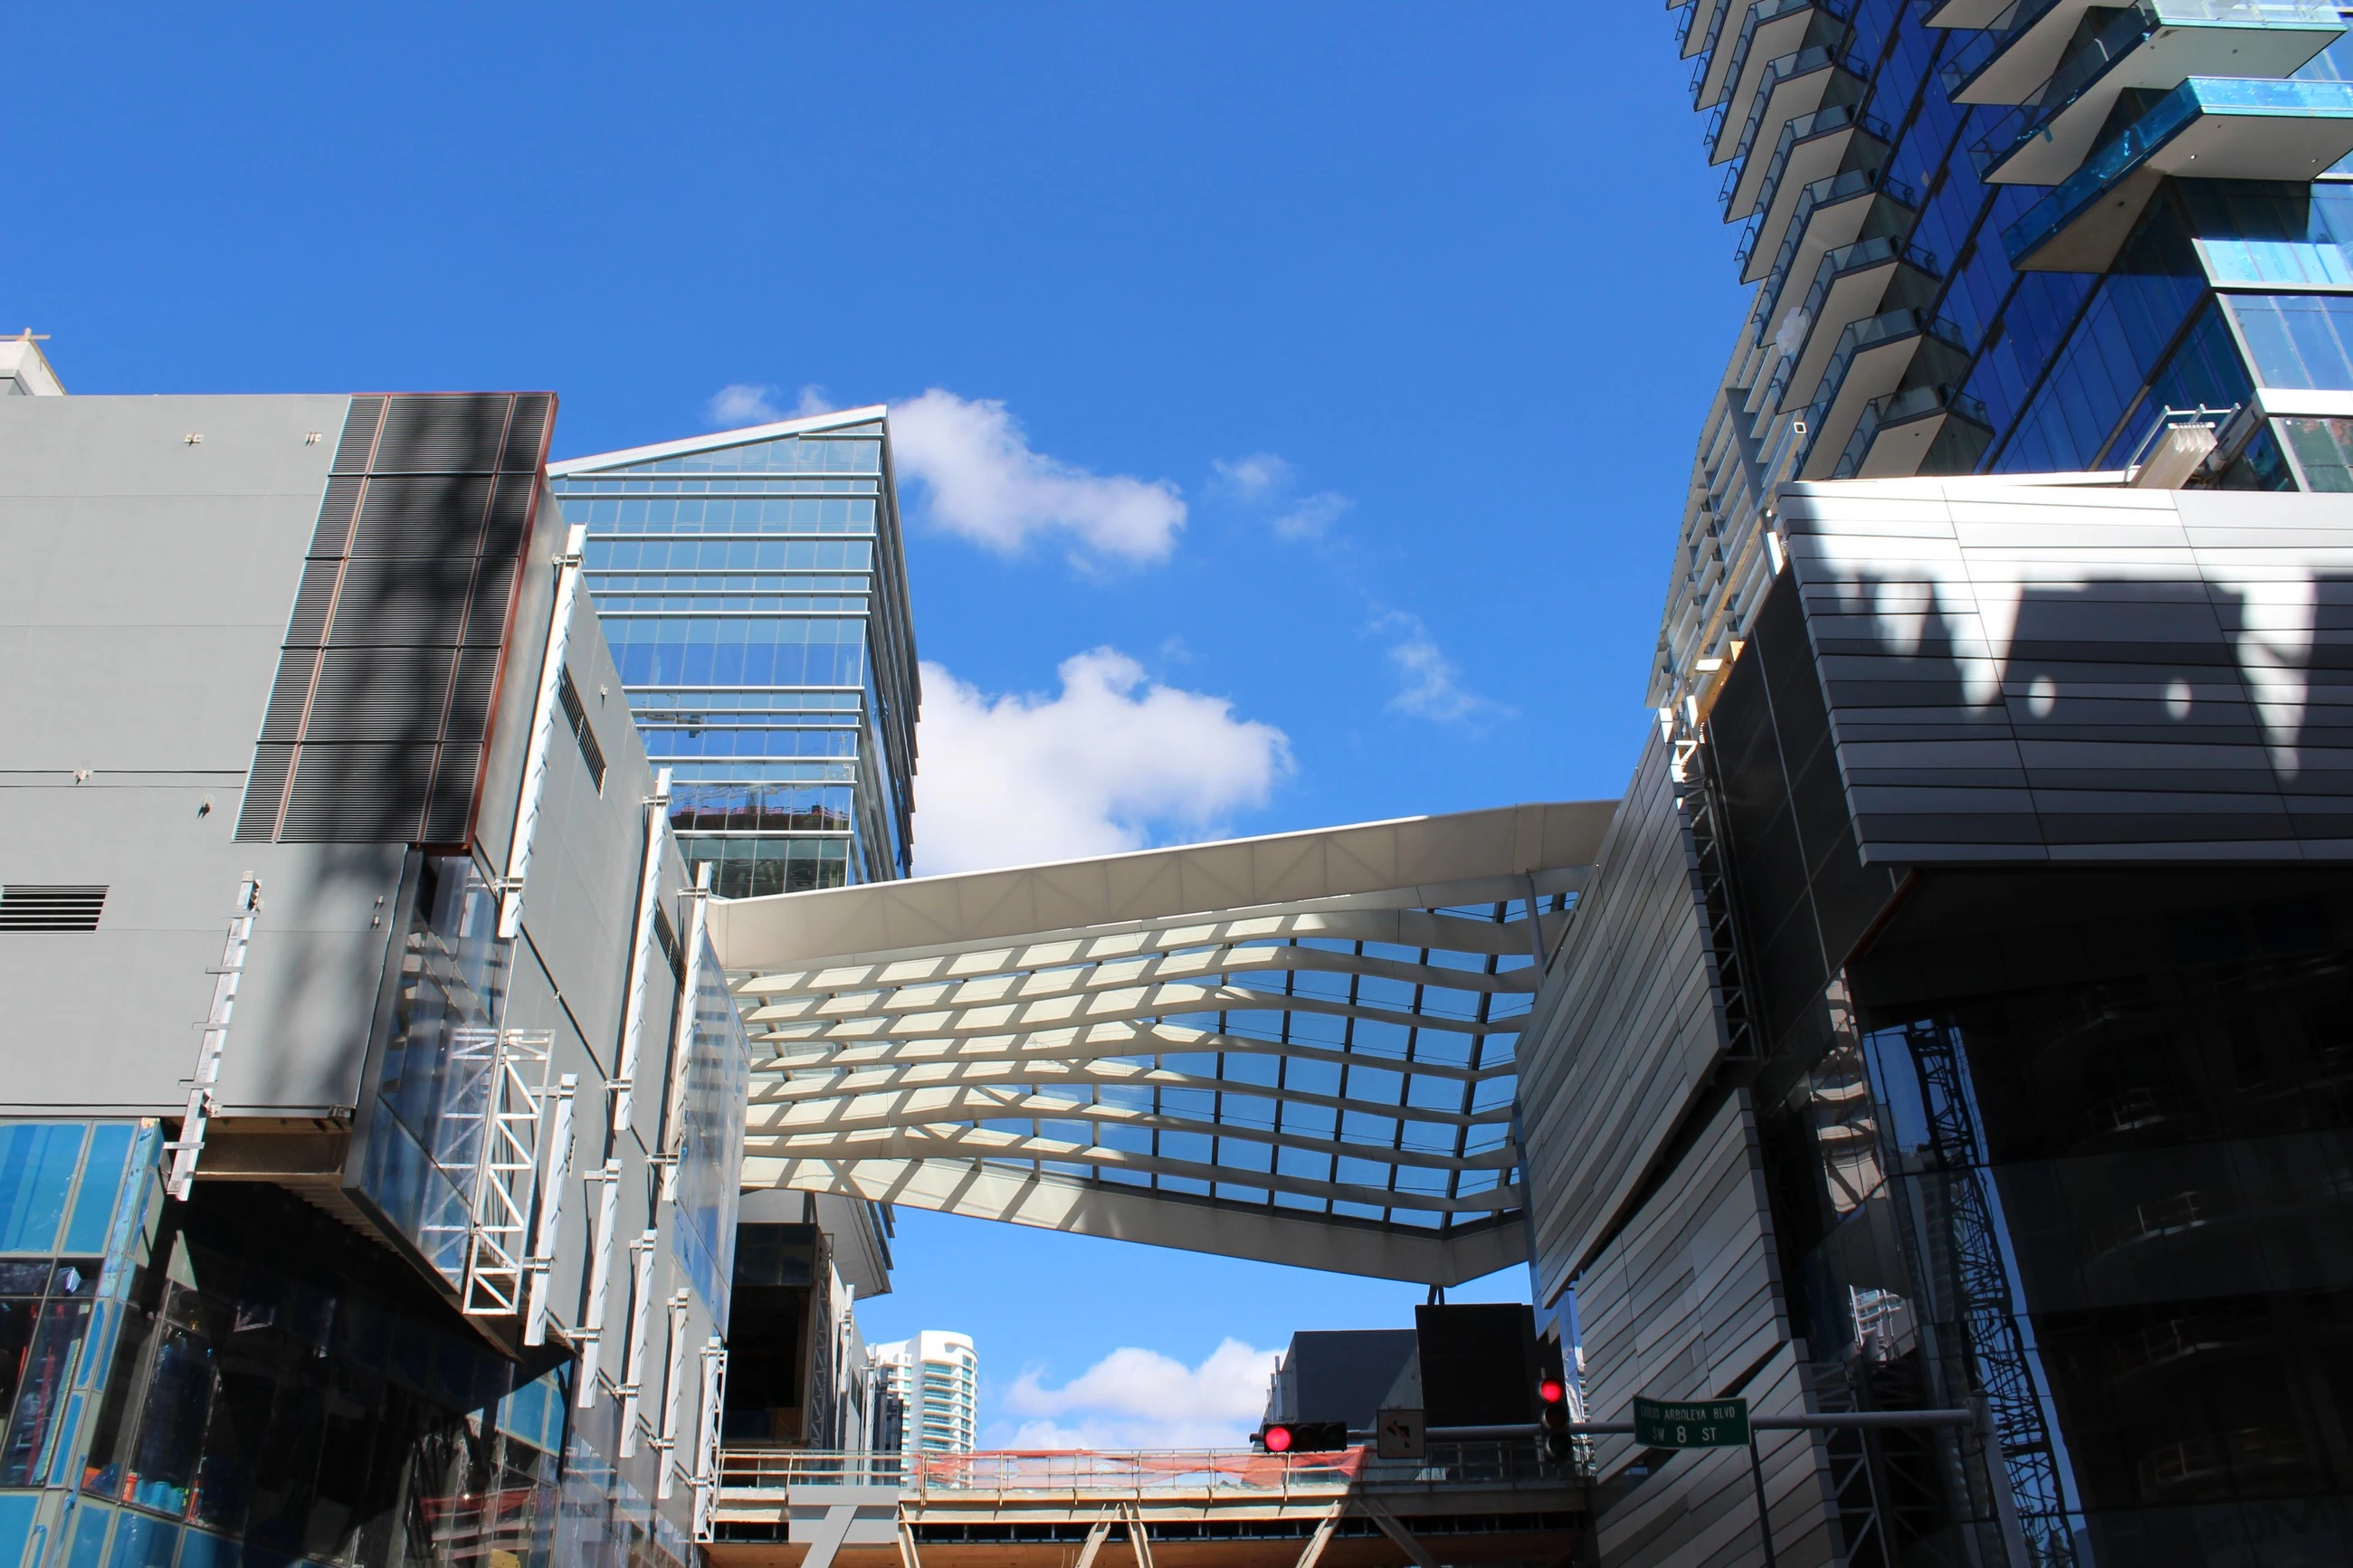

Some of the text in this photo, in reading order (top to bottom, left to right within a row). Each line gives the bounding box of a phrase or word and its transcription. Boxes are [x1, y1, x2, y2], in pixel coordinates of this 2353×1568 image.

[1663, 1408, 1707, 1421] ARBOLEYA
[1712, 1405, 1736, 1420] BLVD
[1652, 1425, 1717, 1444] SW 8 ST
